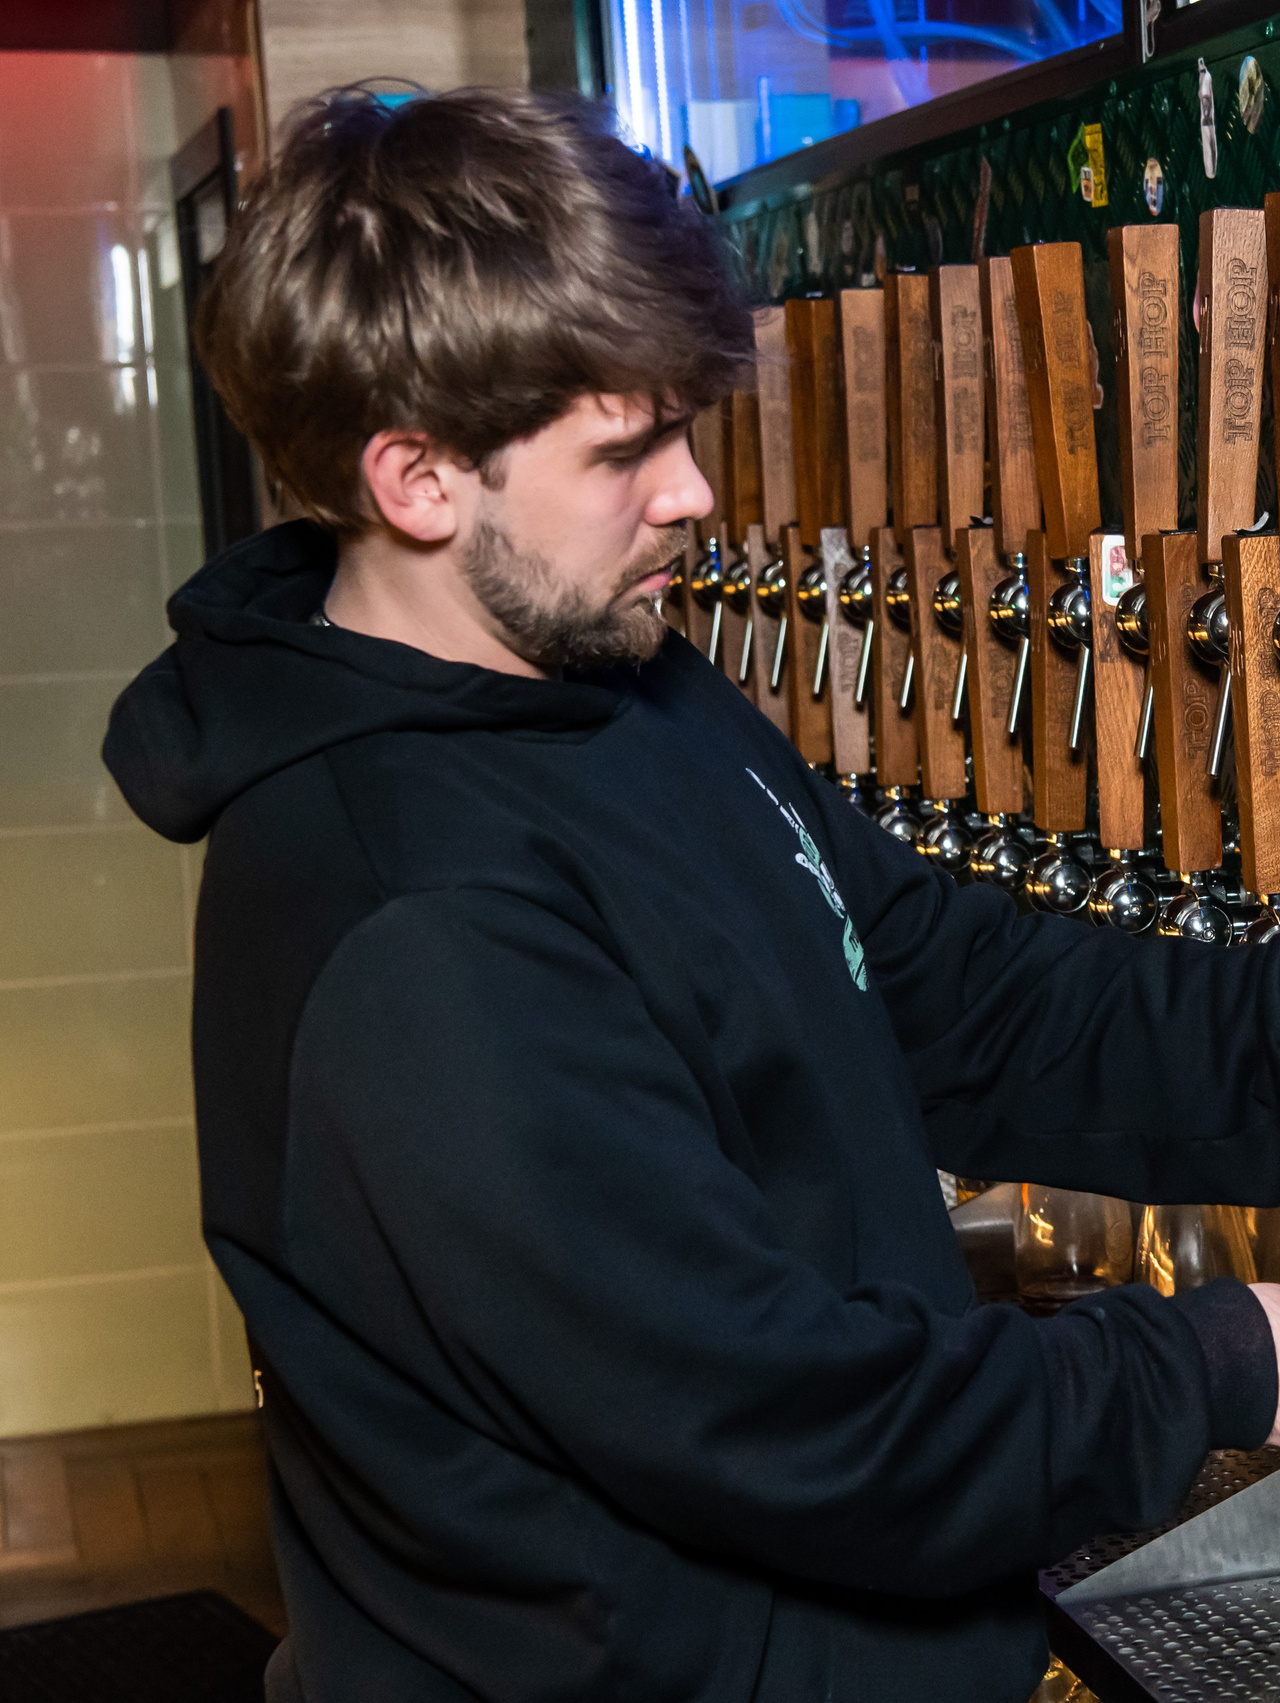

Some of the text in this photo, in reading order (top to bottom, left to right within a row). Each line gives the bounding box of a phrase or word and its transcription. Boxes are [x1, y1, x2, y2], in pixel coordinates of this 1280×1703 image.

[950, 305, 978, 379] HOP
[1052, 289, 1090, 455] TOP HOP
[1138, 271, 1170, 446] TOP HOP
[1223, 257, 1257, 444] TOP HOP
[1183, 677, 1210, 760] TOP
